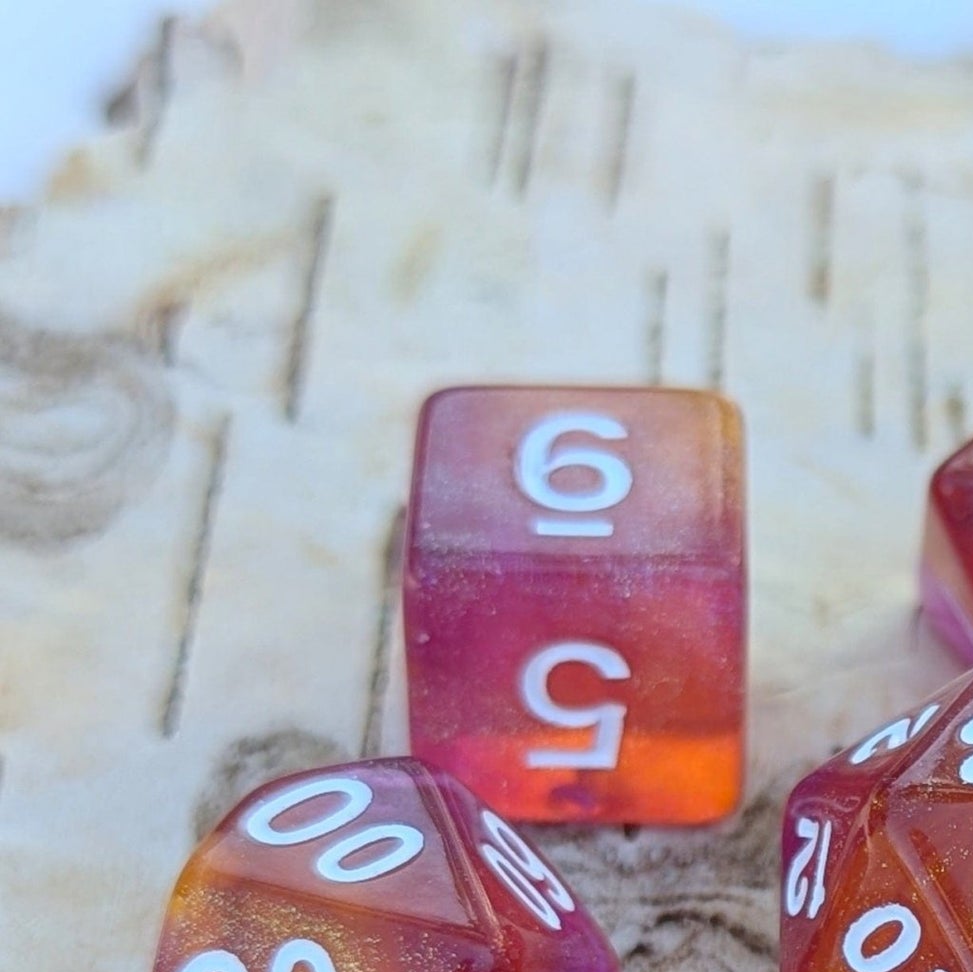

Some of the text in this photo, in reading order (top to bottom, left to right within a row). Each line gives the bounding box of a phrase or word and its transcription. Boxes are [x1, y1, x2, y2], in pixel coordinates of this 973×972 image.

[518, 411, 632, 536] 6
[521, 642, 630, 770] 5
[241, 776, 423, 882] 00
[786, 817, 831, 918] 12
